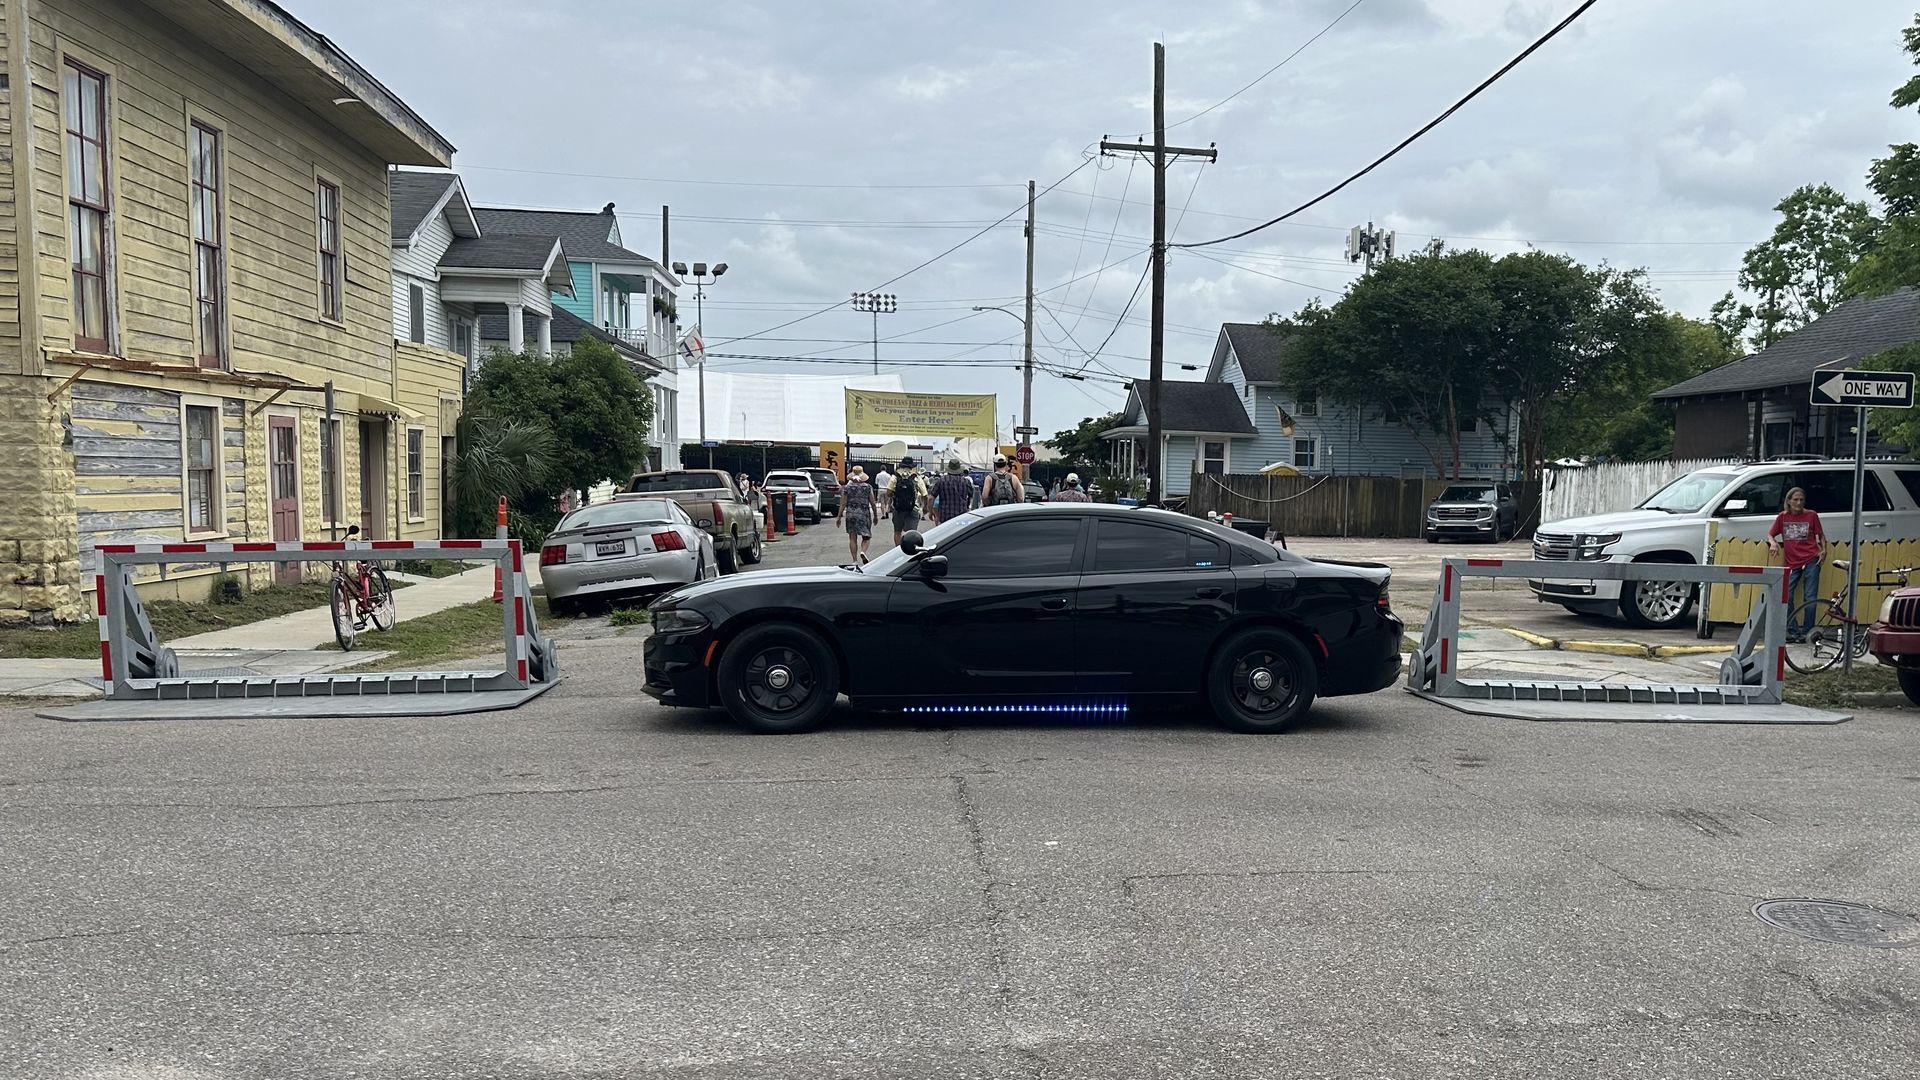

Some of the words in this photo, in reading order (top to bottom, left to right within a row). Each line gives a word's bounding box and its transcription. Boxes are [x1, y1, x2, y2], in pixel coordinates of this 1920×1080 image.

[1844, 382, 1871, 395] ONE
[1876, 383, 1903, 396] WAY
[908, 399, 922, 408] JAZZ
[928, 400, 957, 408] HERITAGE
[899, 415, 926, 424] Enter
[928, 416, 954, 425] Here!
[1017, 452, 1034, 460] STOP
